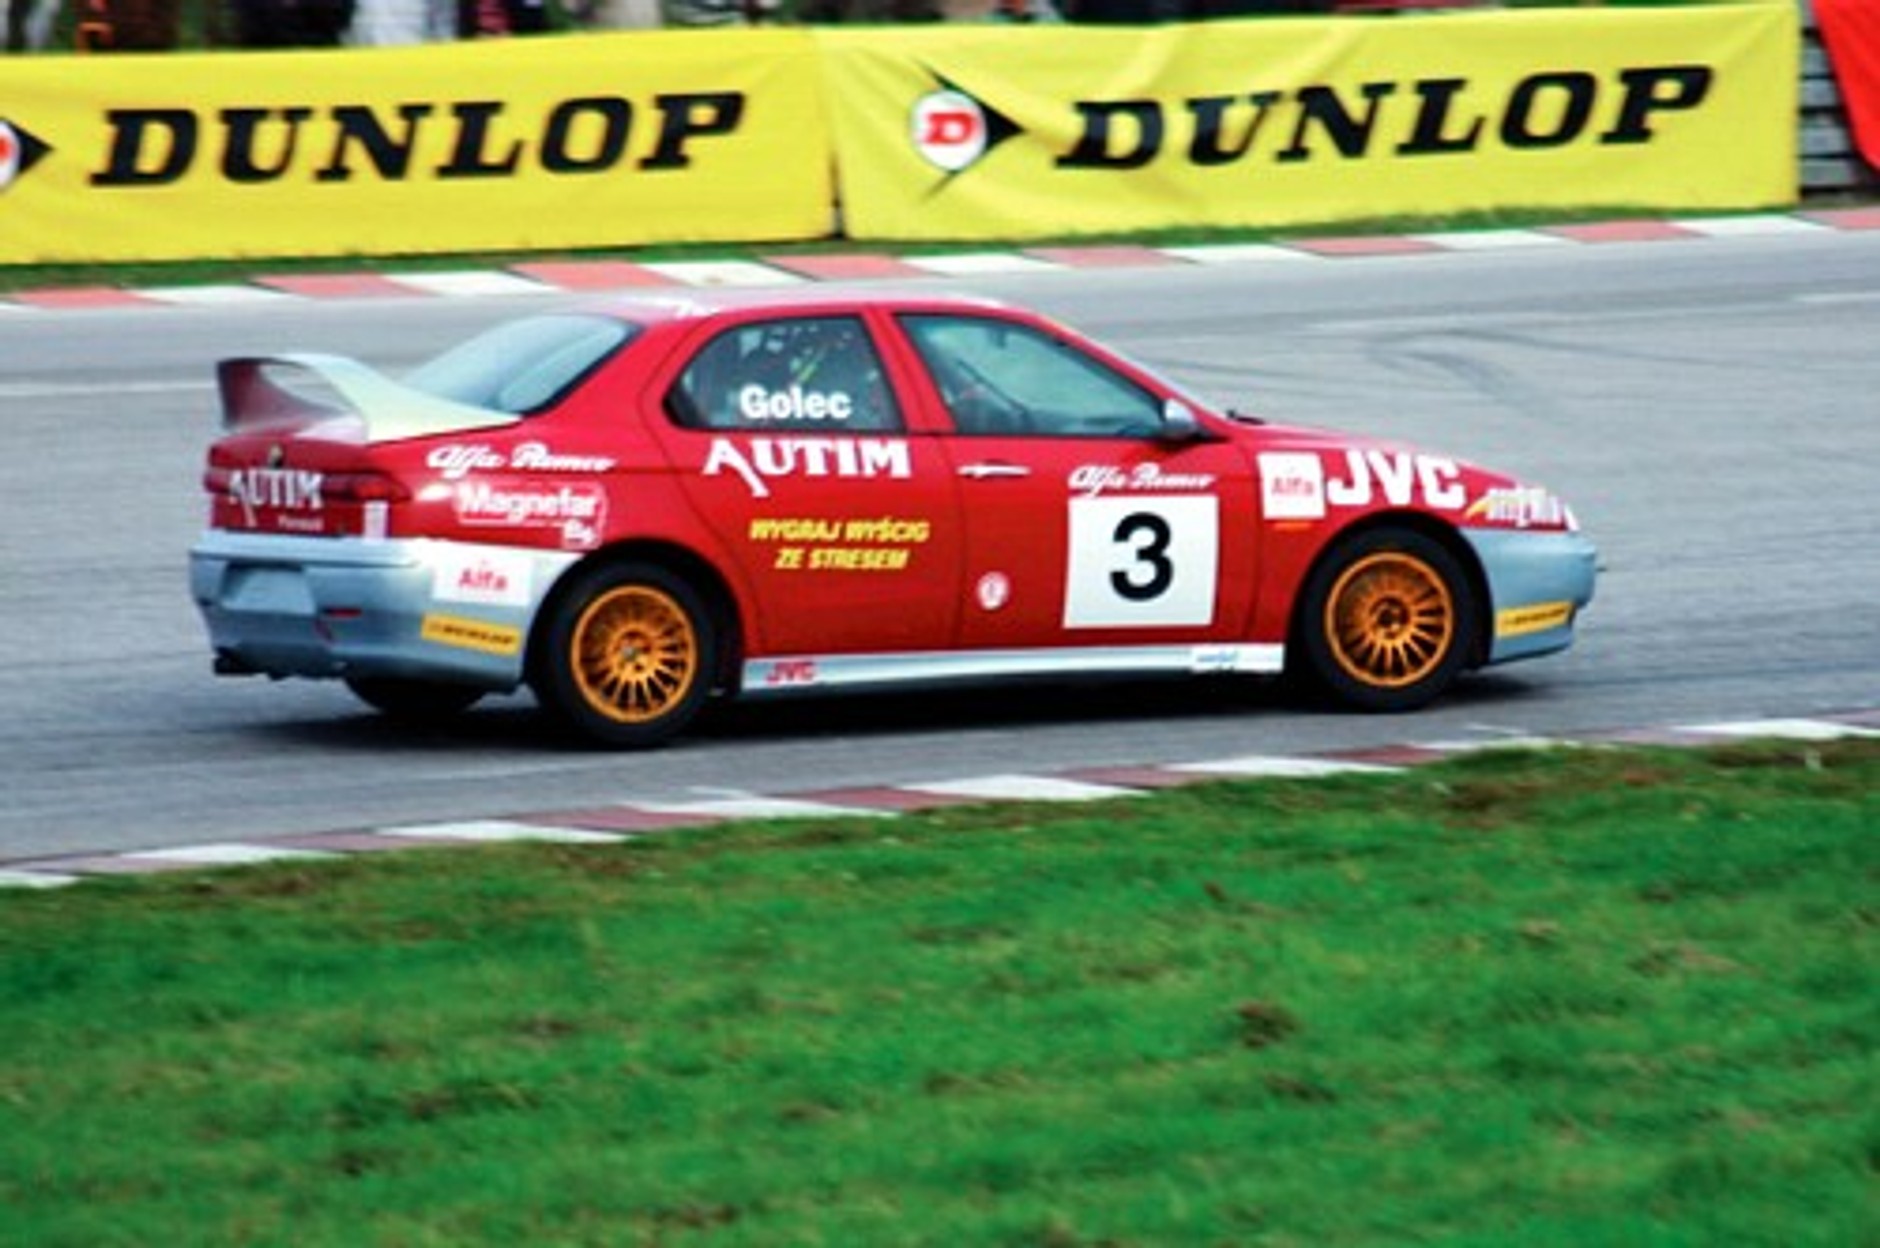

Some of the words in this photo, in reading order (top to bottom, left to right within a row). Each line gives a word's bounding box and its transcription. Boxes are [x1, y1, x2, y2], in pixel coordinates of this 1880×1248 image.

[88, 91, 746, 187] DUNLOP
[1054, 64, 1715, 171] DUNLOP
[739, 383, 853, 419] Golec
[426, 444, 506, 479] Alfa
[511, 441, 617, 471] Romeo
[703, 437, 912, 498] AUTIM
[1326, 449, 1467, 510] JVC
[228, 468, 324, 528] AUTIM
[750, 518, 842, 541] WYGRAJ
[459, 568, 508, 592] Alfa
[774, 547, 805, 570] ZE
[808, 547, 911, 570] STRESEM
[1109, 511, 1175, 602] 3
[765, 661, 816, 686] JVC
